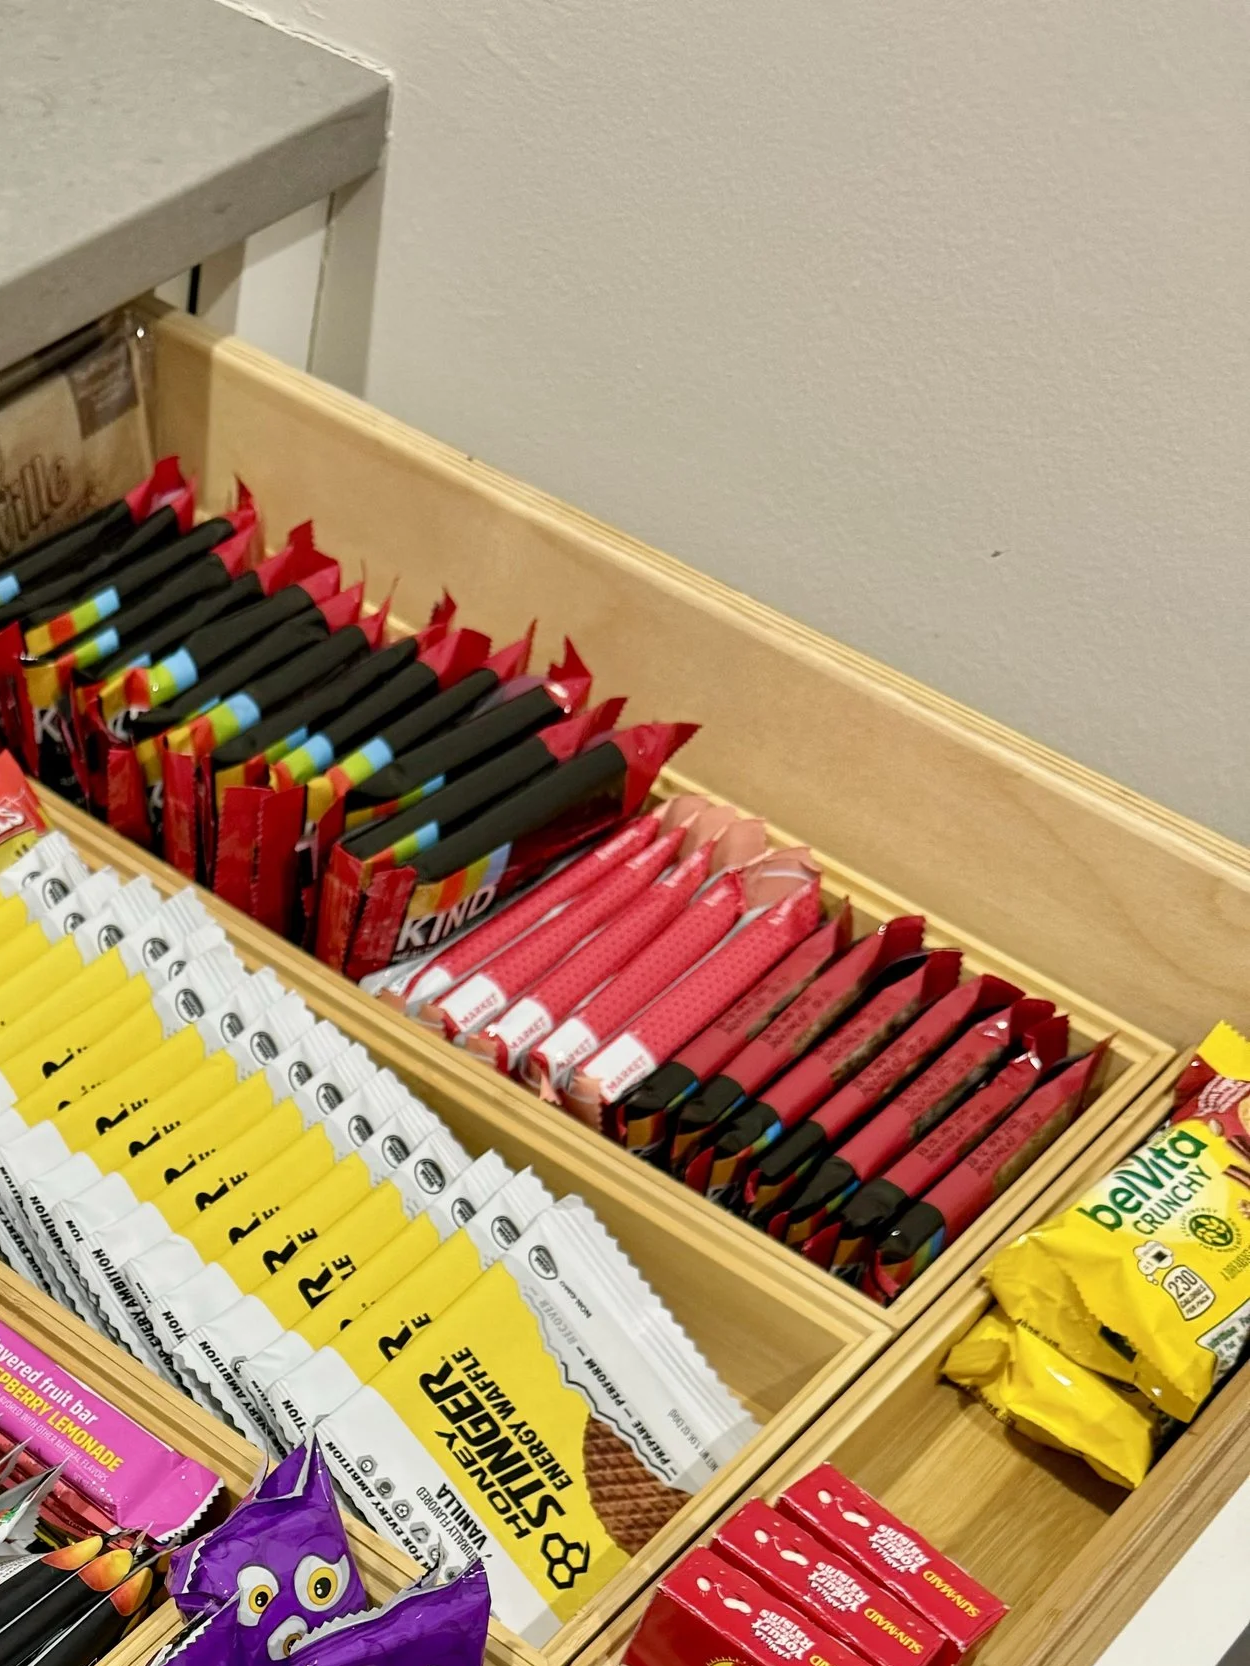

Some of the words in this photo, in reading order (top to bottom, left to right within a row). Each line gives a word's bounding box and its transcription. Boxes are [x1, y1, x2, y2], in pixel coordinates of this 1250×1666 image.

[395, 884, 499, 953] KIND
[459, 992, 499, 1027] MARKET
[509, 1016, 547, 1051] MARKET
[607, 1055, 647, 1092] MARKET
[1076, 1128, 1210, 1233] belVita
[1133, 1164, 1213, 1236] CRUNCHY
[1167, 1269, 1198, 1299] 230
[37, 1373, 77, 1409] fruit
[70, 1400, 99, 1427] bar
[452, 1346, 522, 1420] WAFFLE
[584, 1357, 626, 1407] PERFORM
[46, 1407, 124, 1473] LEMONADE
[418, 1358, 566, 1531] STINGER
[509, 1414, 574, 1492] ENERGY
[632, 1419, 671, 1467] PREPARE
[433, 1429, 532, 1540] HONEY
[436, 1482, 489, 1550] VANILLA
